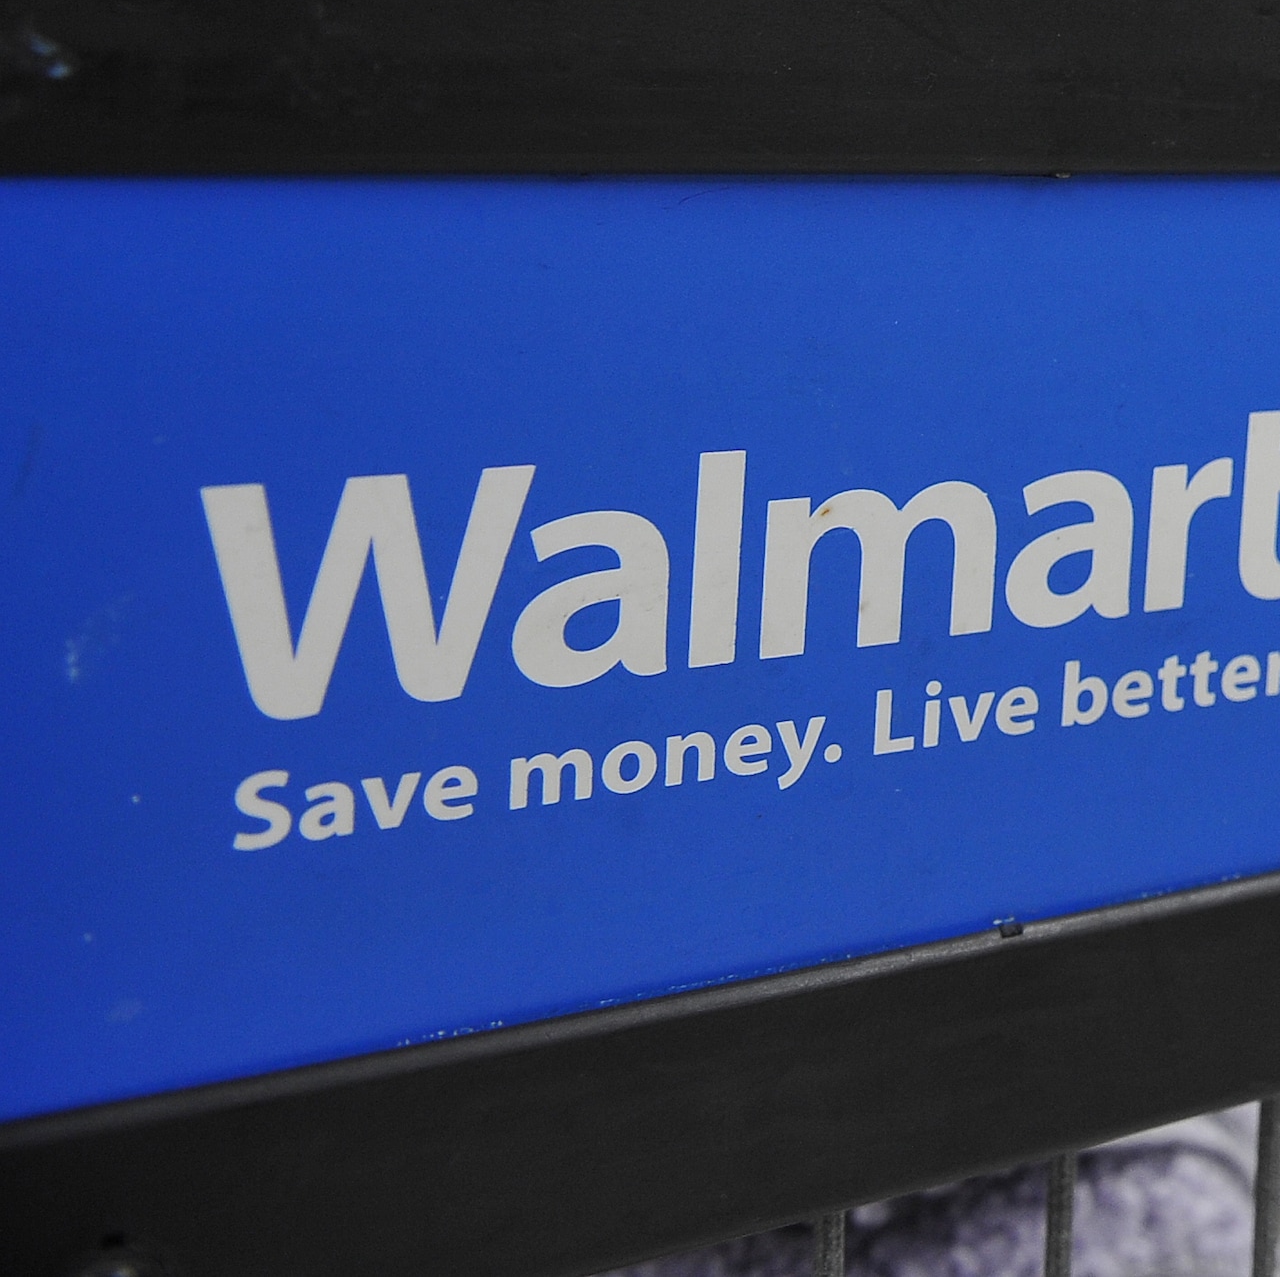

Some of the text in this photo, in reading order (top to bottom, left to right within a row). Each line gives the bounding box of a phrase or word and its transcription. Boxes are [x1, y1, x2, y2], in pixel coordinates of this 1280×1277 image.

[233, 766, 478, 851] Save
[509, 716, 842, 810] money.
[873, 680, 1040, 756] Live
